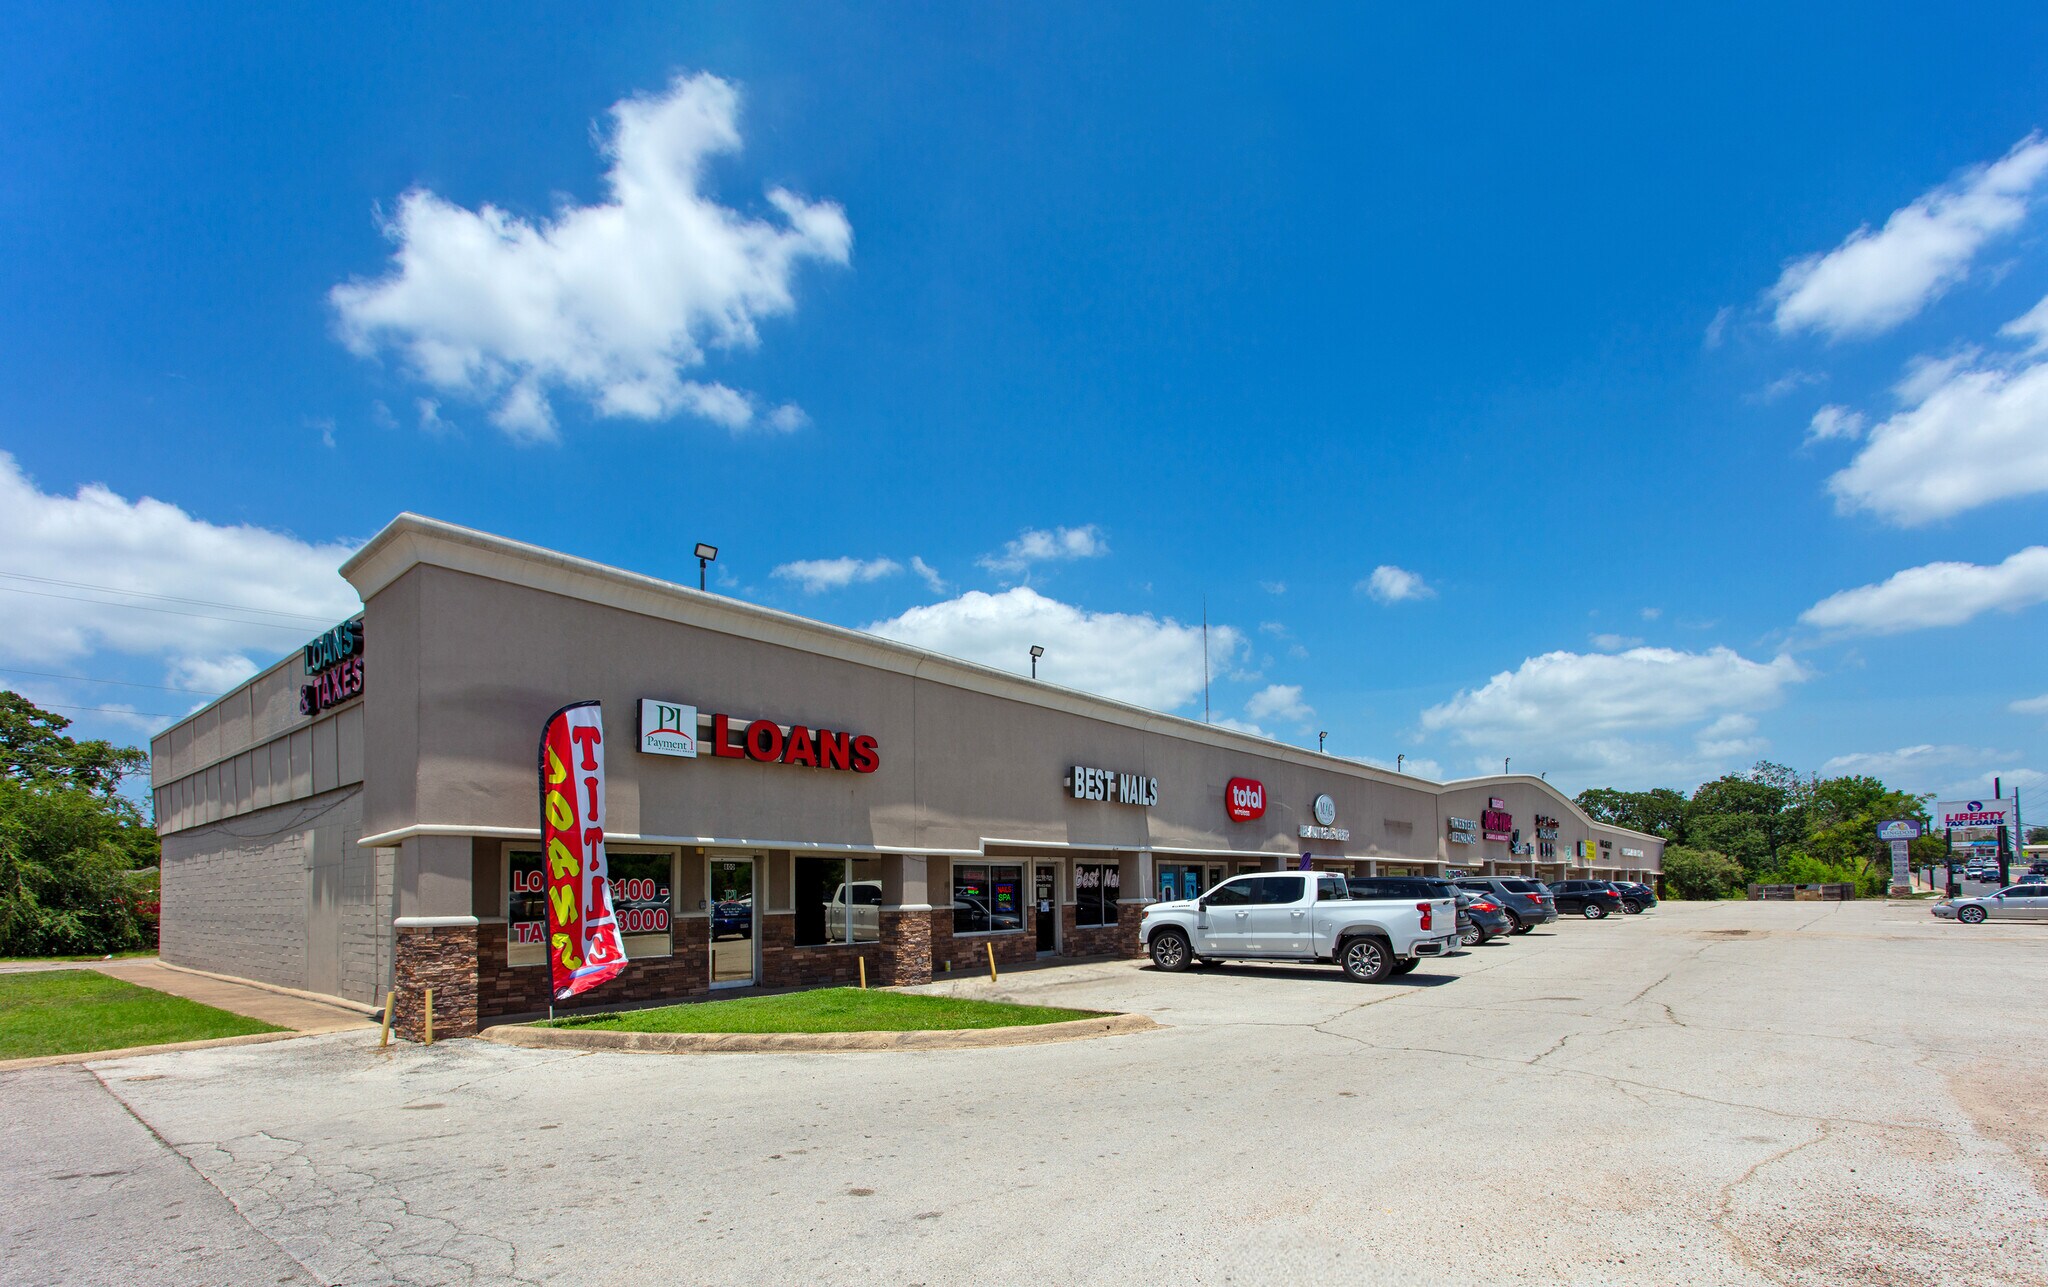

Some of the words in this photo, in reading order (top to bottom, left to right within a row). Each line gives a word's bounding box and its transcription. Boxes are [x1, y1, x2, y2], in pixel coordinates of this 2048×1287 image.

[304, 620, 354, 675] LOANS
[313, 657, 363, 710] TAXES
[647, 735, 688, 750] Payment
[712, 713, 880, 773] LOANS
[1072, 765, 1115, 802] BEST
[1119, 773, 1158, 807] NAILS
[1233, 785, 1263, 809] total
[1234, 808, 1251, 817] wireless
[1945, 810, 2007, 822] LIBERTY
[1969, 818, 2005, 826] LOANS
[1075, 866, 1100, 889] Best
[997, 885, 1012, 893] NAILS
[997, 893, 1011, 902] SPA
